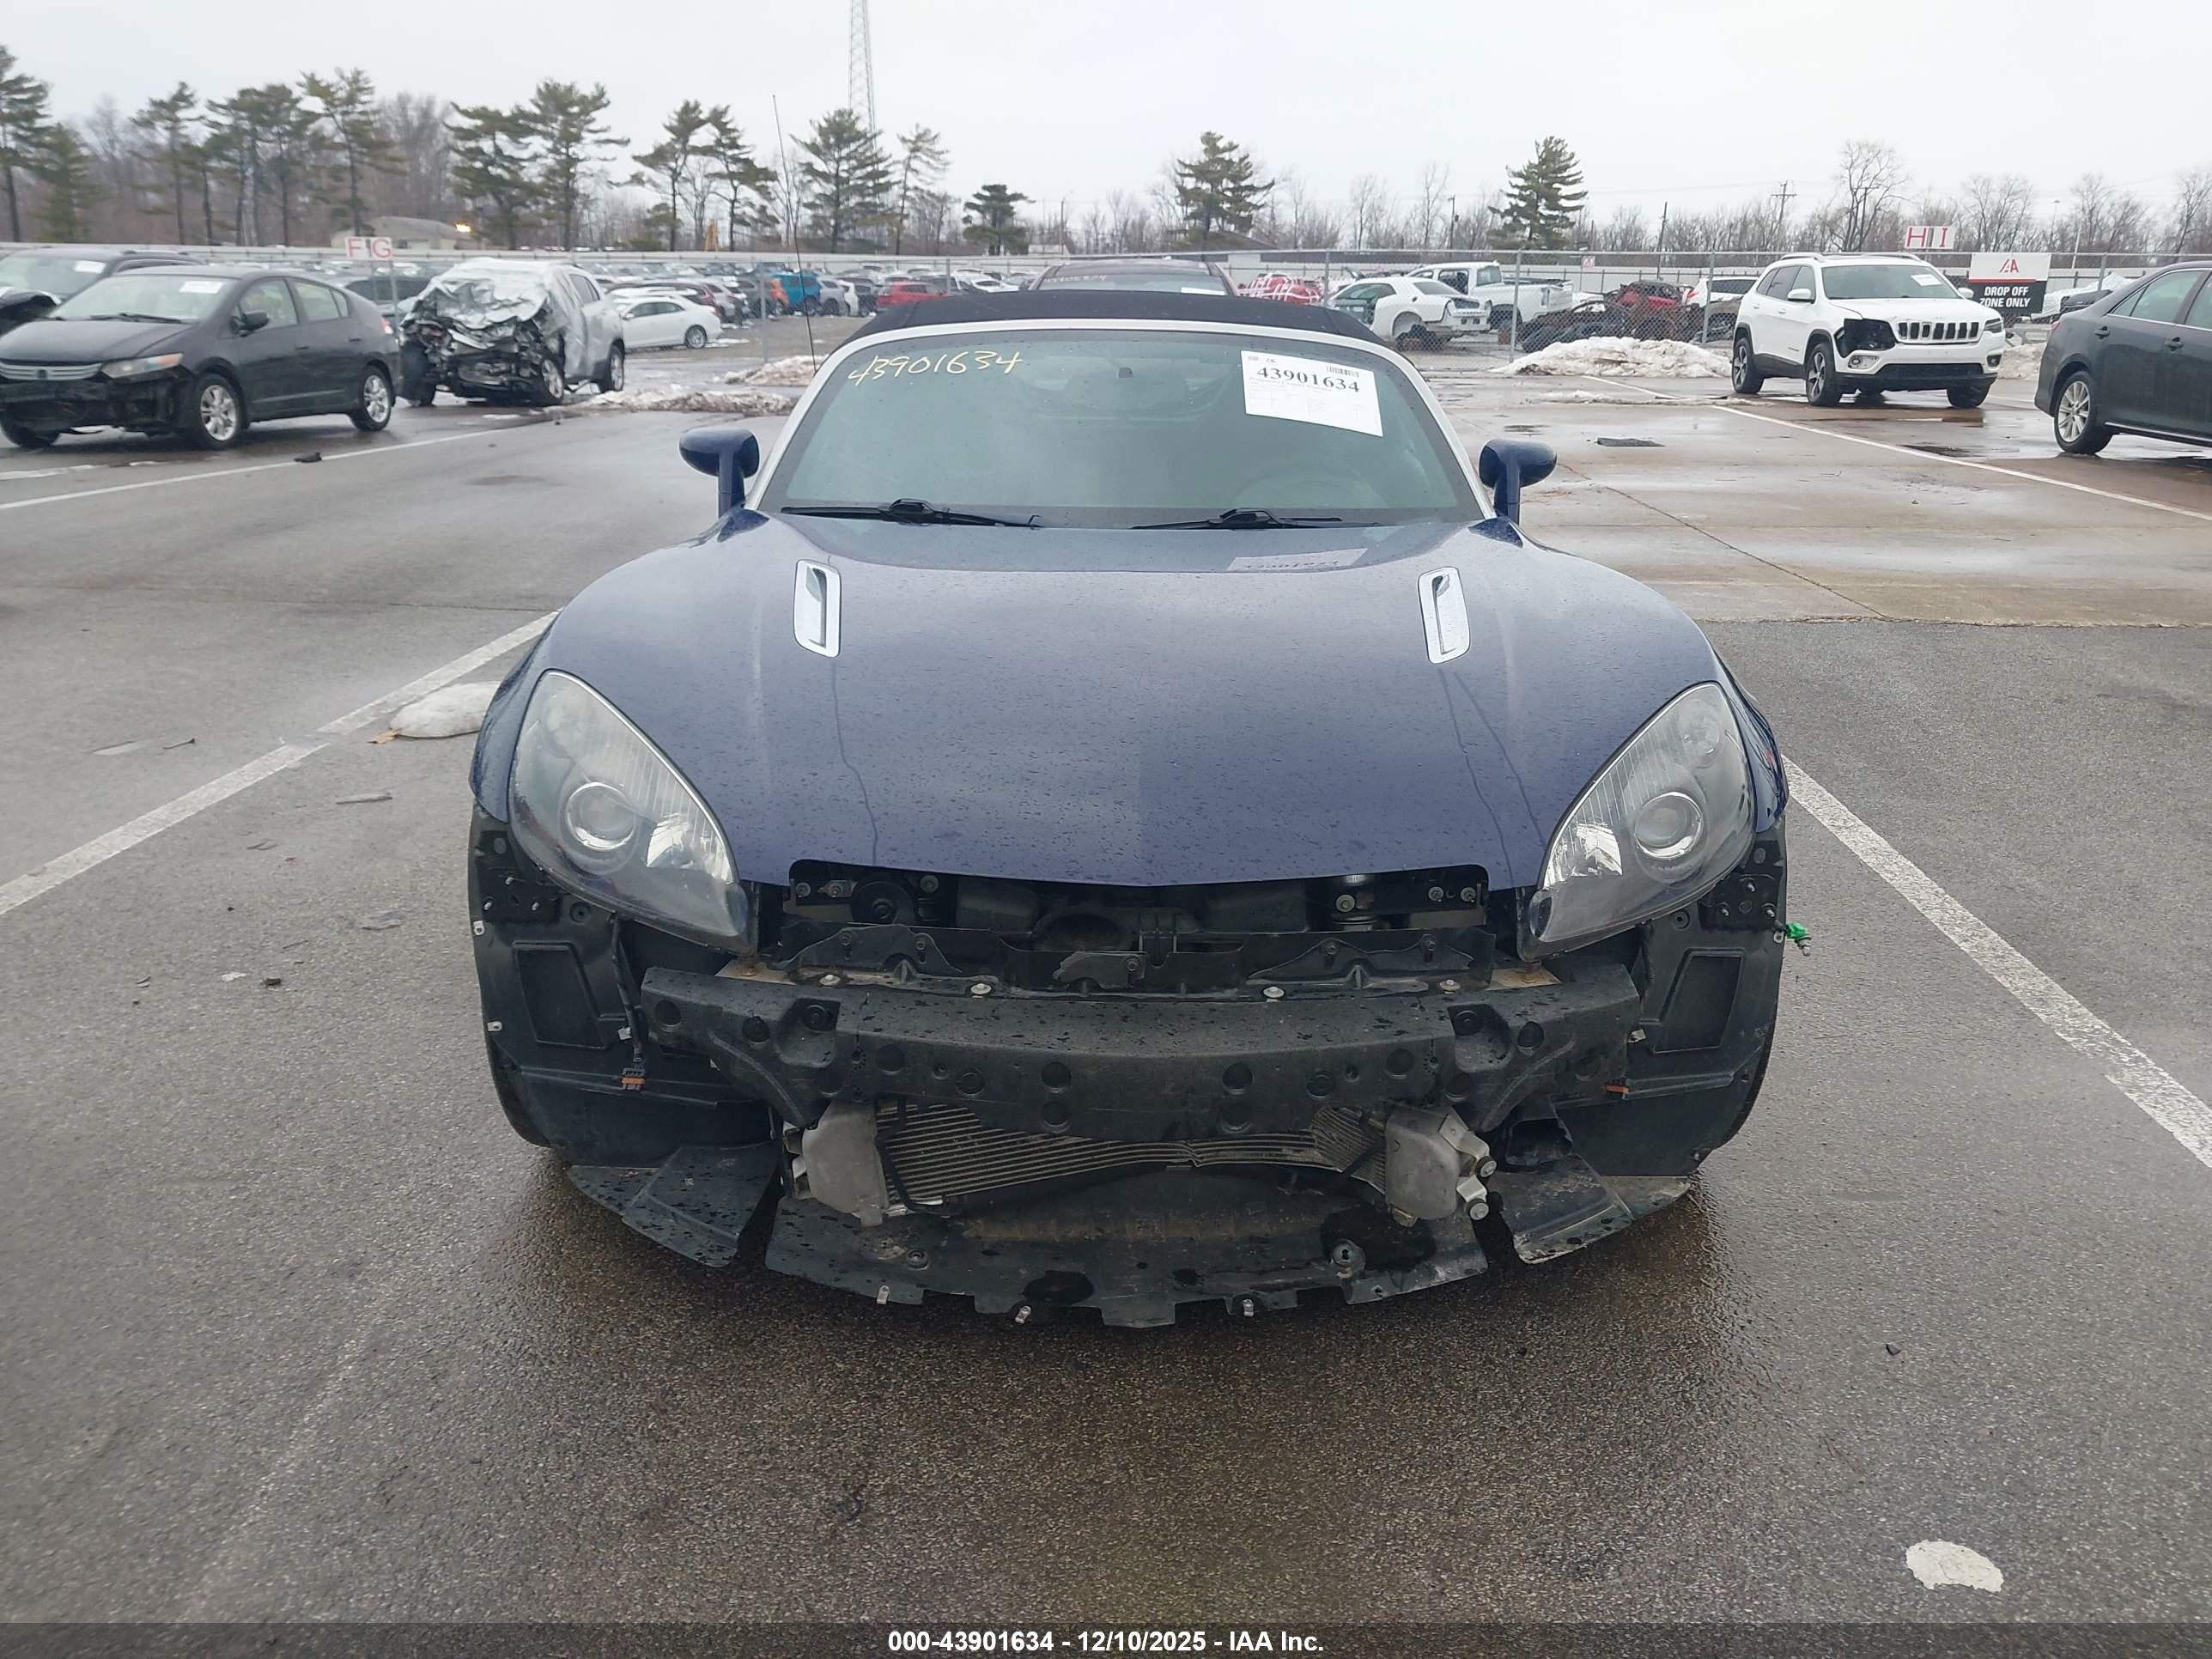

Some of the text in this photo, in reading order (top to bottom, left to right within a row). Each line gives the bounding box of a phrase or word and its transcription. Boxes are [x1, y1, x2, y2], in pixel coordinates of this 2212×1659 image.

[1984, 286, 2029, 296] DROP OFF
[1979, 297, 2031, 308] ZONE ONLY
[848, 351, 1023, 386] 43901634
[1256, 366, 1361, 392] 43901634
